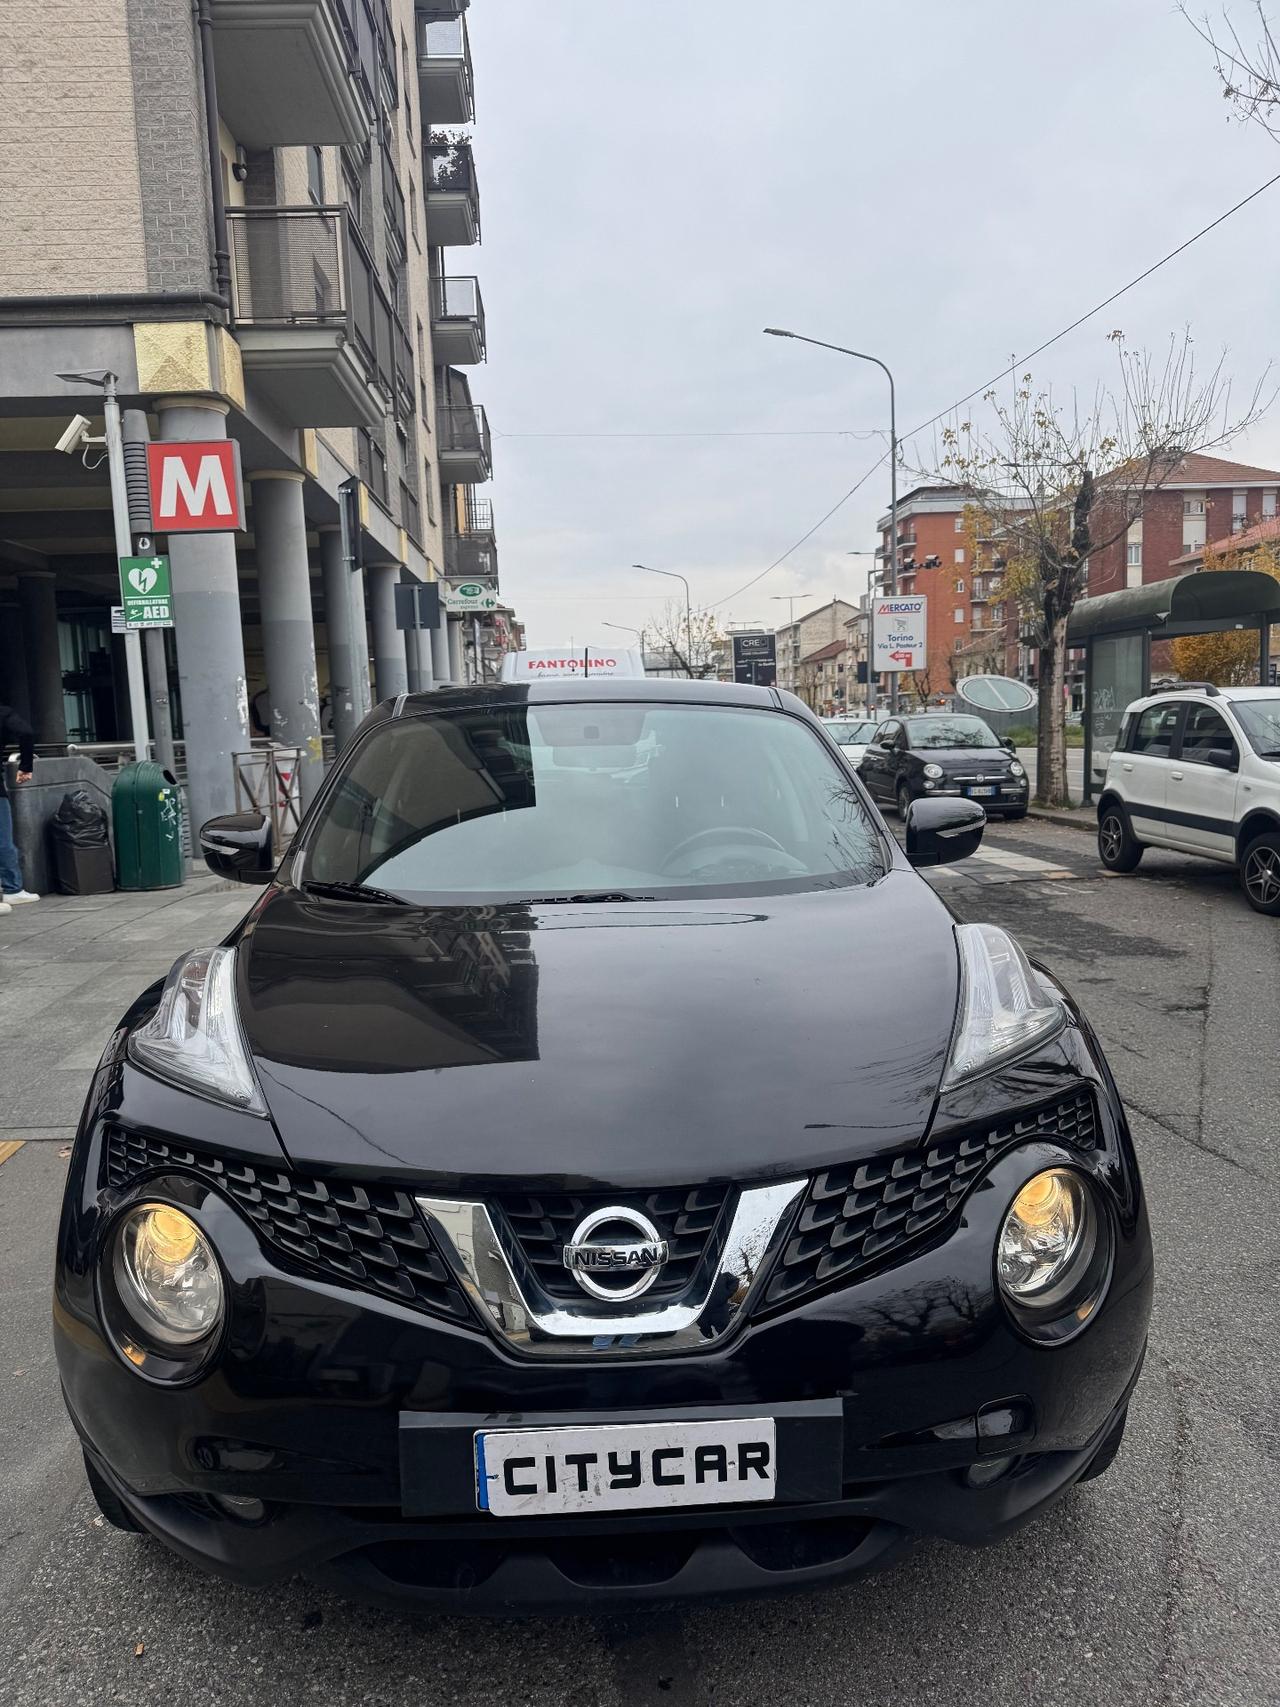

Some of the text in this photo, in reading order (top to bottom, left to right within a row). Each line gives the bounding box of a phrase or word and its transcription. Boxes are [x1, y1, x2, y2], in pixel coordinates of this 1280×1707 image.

[160, 454, 233, 517] M
[143, 606, 170, 619] AED
[878, 602, 922, 614] MERCATO
[888, 633, 914, 642] Torino
[528, 659, 617, 670] FANTOLINO
[574, 1246, 659, 1268] NISSAN
[503, 1441, 770, 1495] CITYCAR
